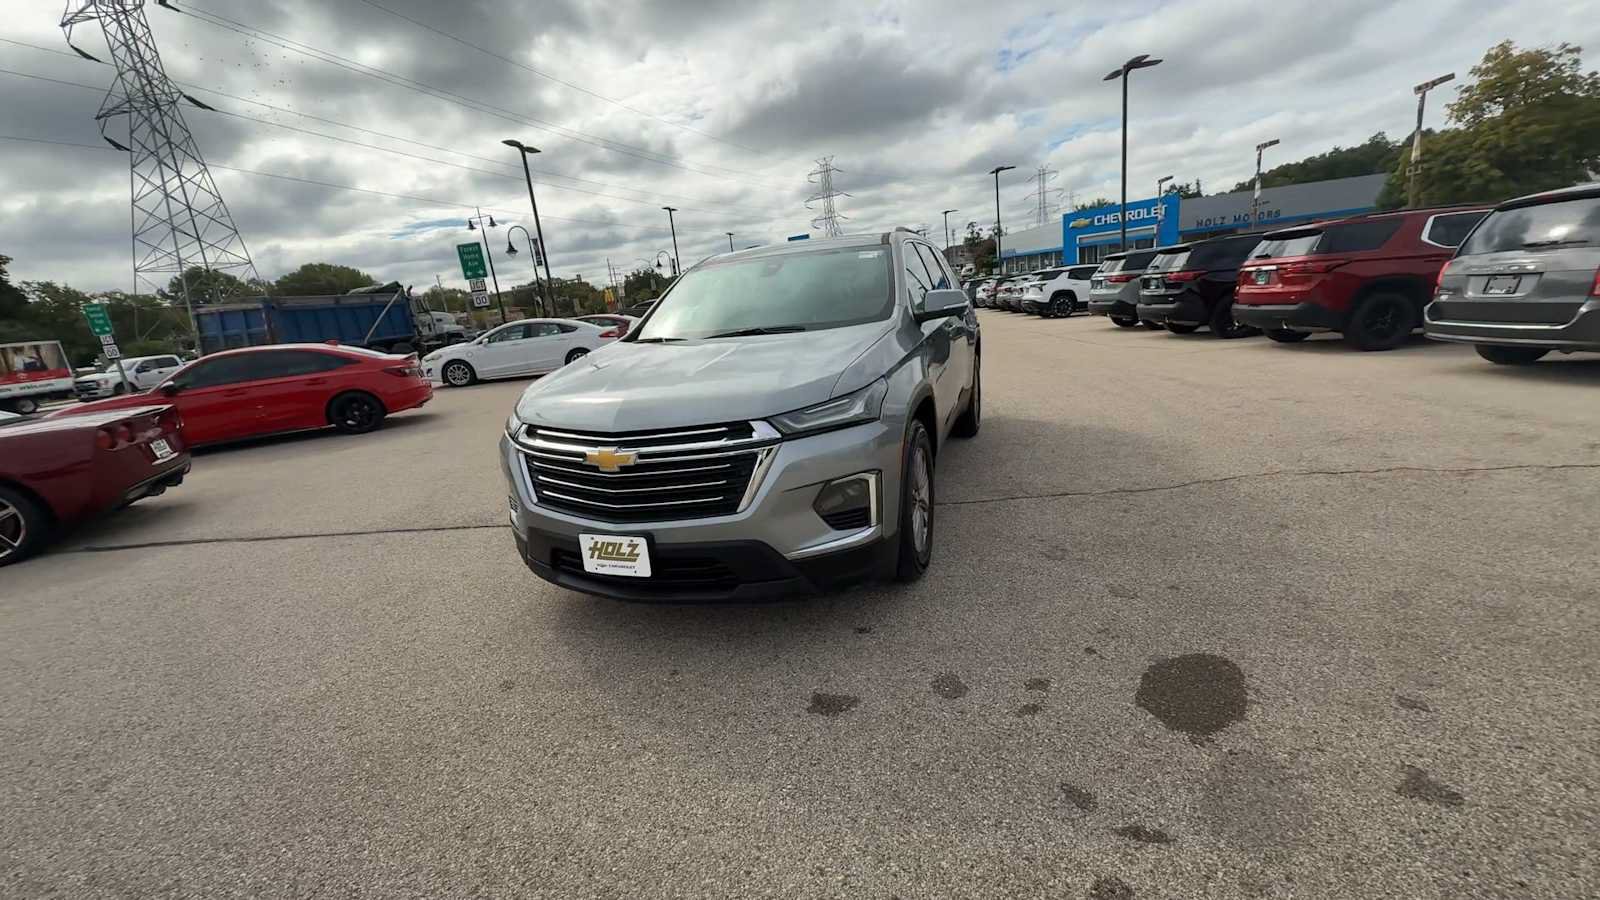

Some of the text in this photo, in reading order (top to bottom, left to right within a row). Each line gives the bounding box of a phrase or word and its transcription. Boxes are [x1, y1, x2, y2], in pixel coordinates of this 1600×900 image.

[1196, 209, 1280, 227] HOLZ MOORS
[588, 540, 641, 563] HOLZ
